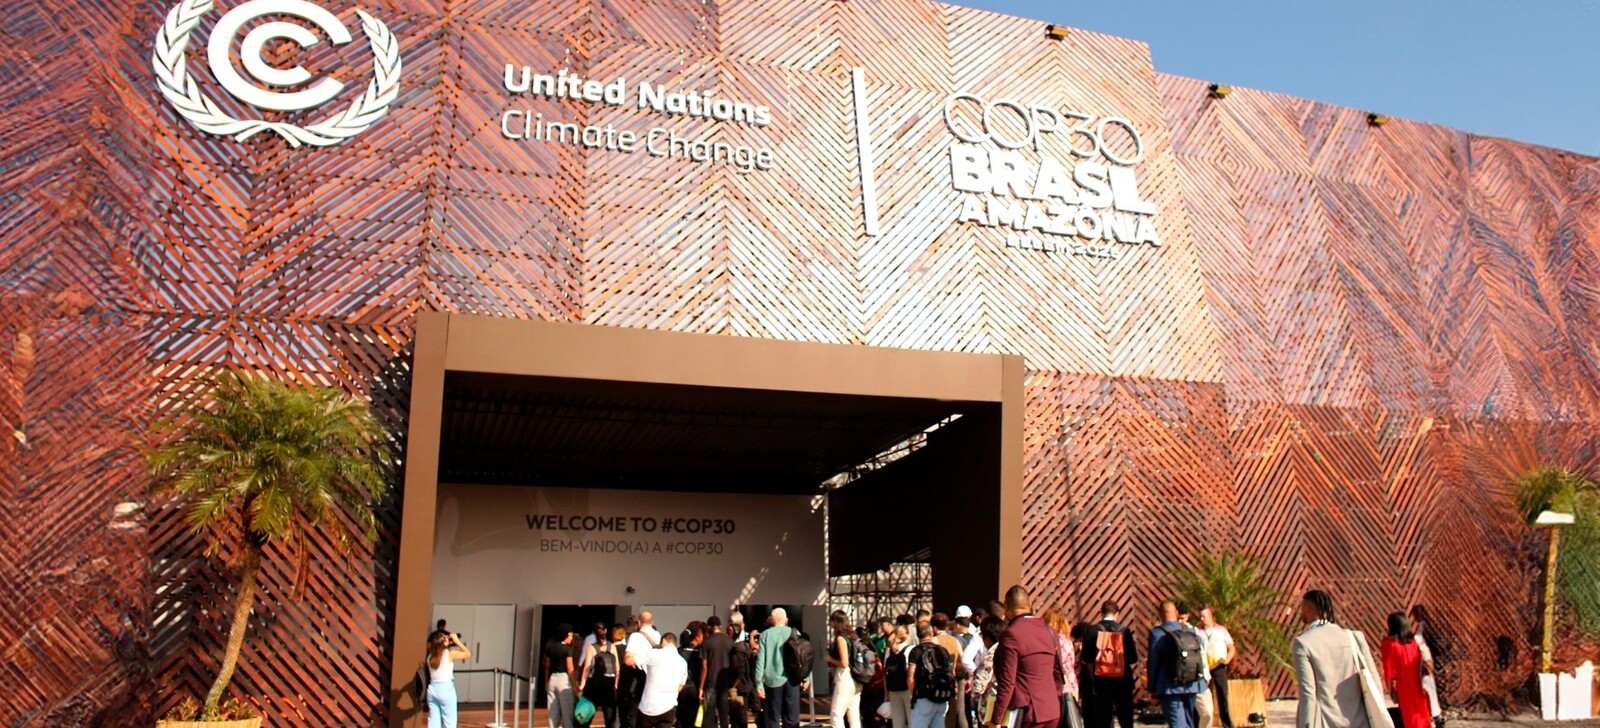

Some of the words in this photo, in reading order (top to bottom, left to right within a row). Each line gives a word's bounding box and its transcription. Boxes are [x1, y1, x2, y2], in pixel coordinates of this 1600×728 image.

[504, 63, 626, 105] United
[639, 82, 771, 126] Nations
[501, 110, 637, 152] Climate
[647, 127, 773, 174] Change
[943, 92, 1143, 166] COP30
[949, 144, 1157, 216] BRASIL
[526, 514, 626, 532] WELCOME
[631, 517, 656, 533] TO
[661, 518, 736, 535] #COP30
[540, 539, 648, 555] BEM-VINDO(A)
[653, 541, 662, 554] A
[666, 543, 724, 555] #COP30
